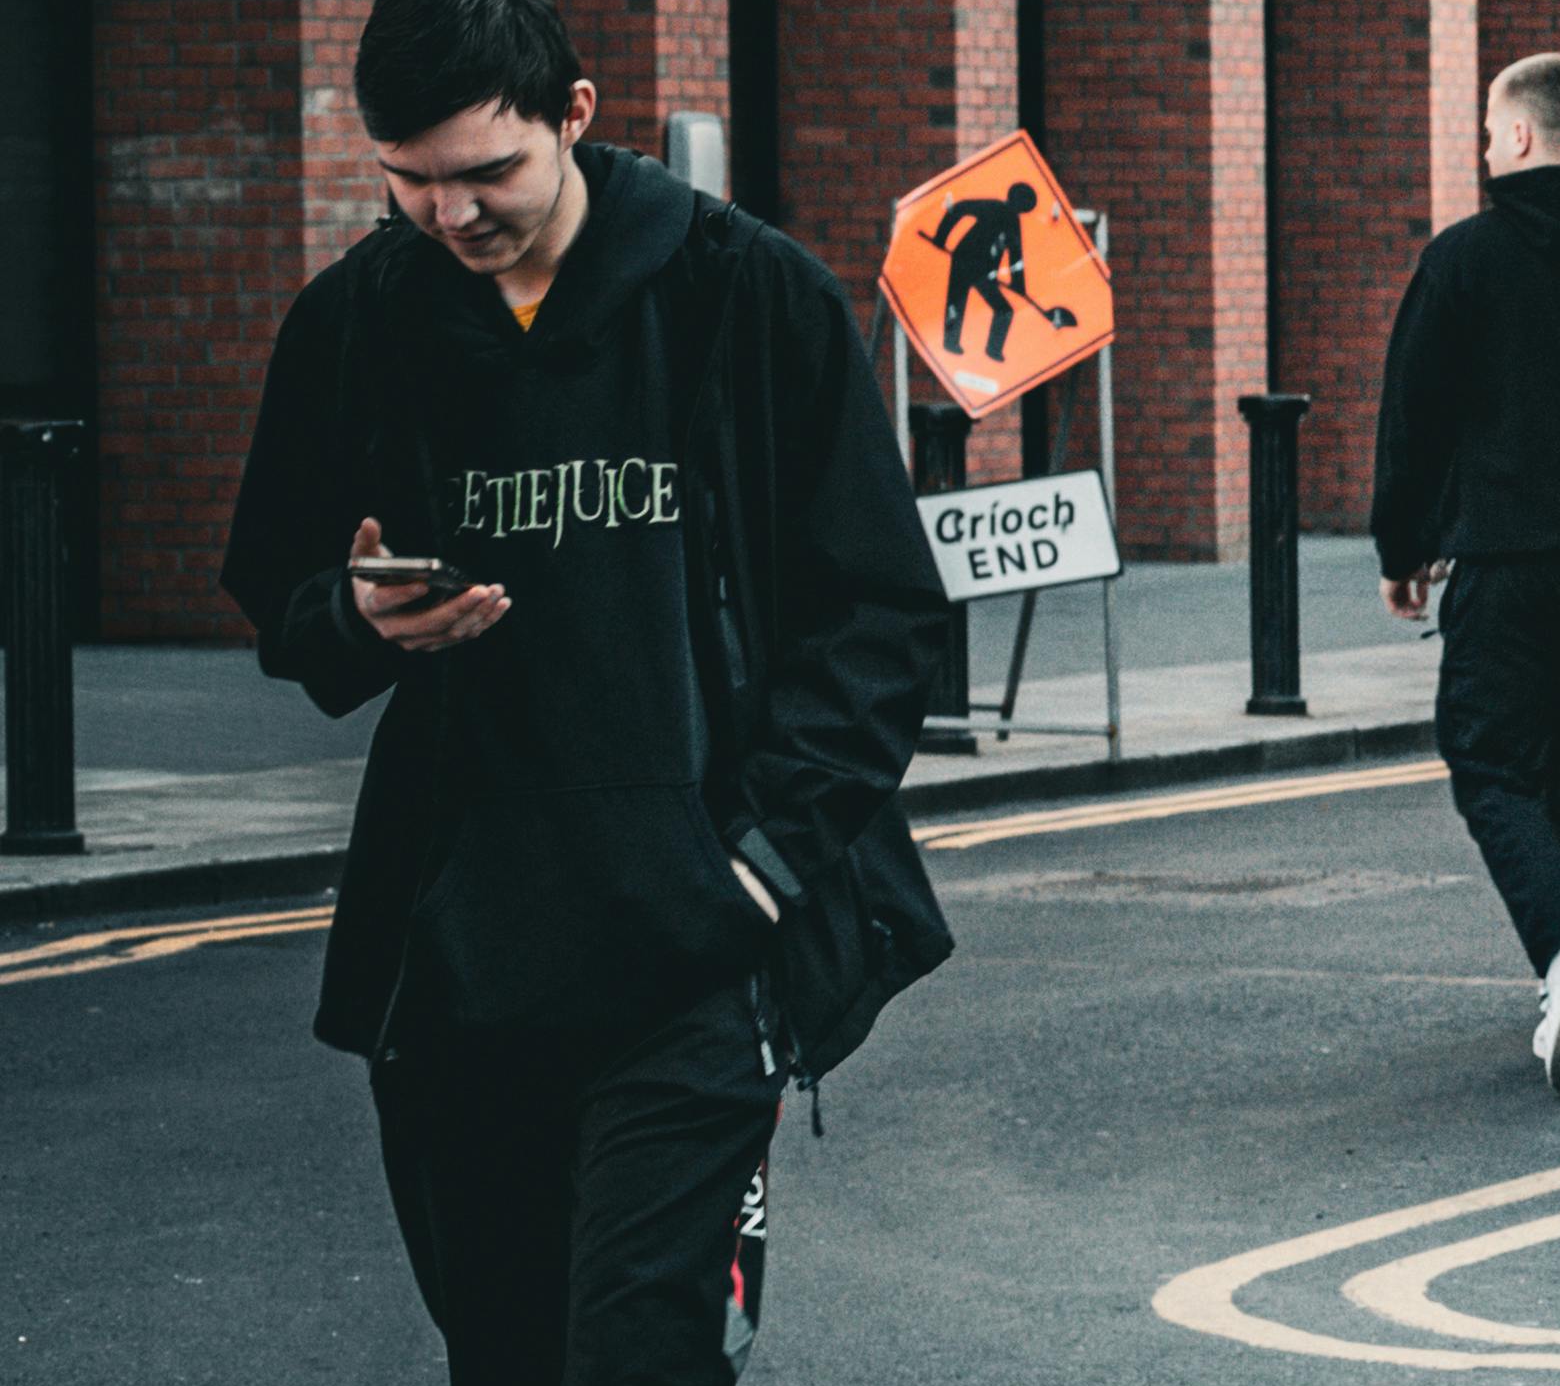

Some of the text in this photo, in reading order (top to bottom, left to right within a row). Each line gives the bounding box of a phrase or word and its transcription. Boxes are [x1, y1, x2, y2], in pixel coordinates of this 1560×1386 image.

[448, 457, 681, 550] ETLEJUICE
[935, 492, 1075, 544] Críoch
[968, 539, 1059, 580] END
